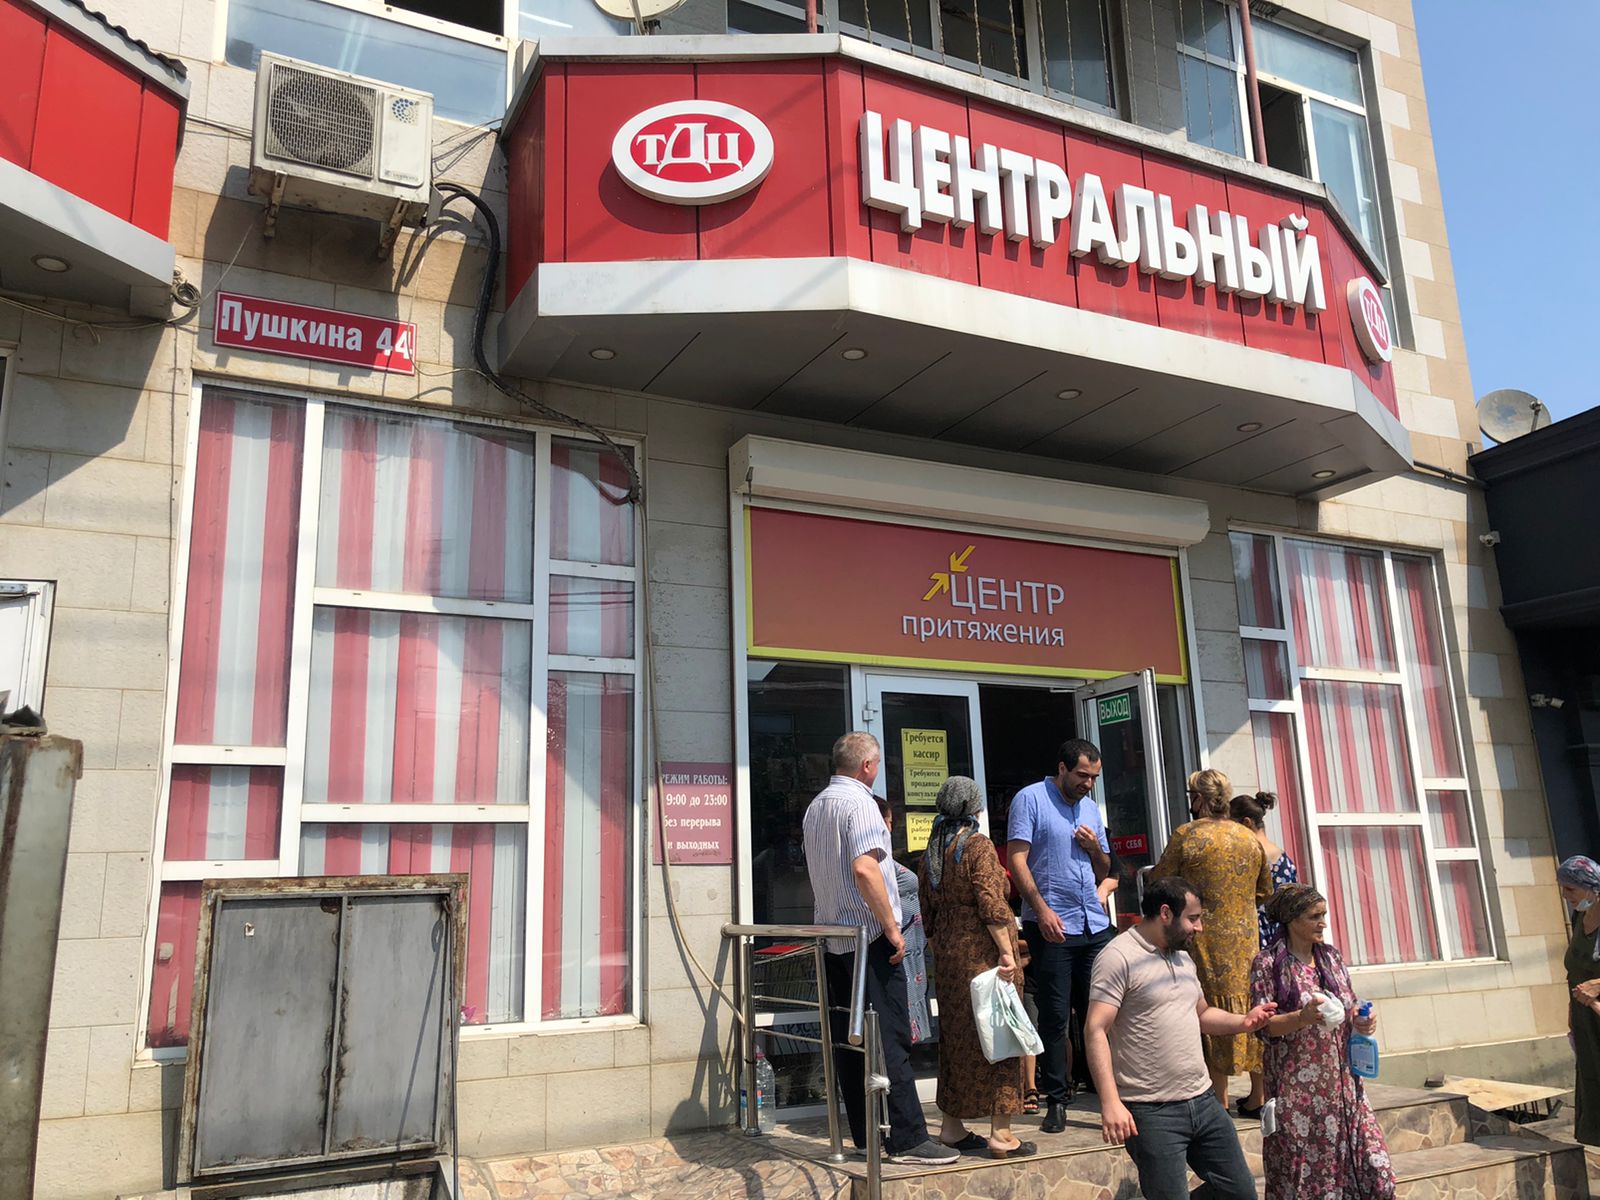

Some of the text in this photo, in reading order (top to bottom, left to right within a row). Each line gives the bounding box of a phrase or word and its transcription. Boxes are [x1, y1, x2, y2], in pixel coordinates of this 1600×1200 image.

[860, 110, 1326, 314] ЦЕНТРАЛЬНЫЙ
[221, 299, 413, 359] Пушкина 44
[951, 574, 1065, 615] ЦЕНТР
[902, 615, 1065, 647] притяжения
[1100, 698, 1129, 720] ВЫХОД
[905, 732, 944, 746] Требуется
[913, 750, 940, 761] кассир
[693, 774, 728, 785] РАБОТЫ:
[910, 769, 941, 778] Требуются
[666, 793, 728, 807] 9:00 до 23:00
[680, 818, 721, 829] перерыва
[676, 841, 720, 850] выходных
[1112, 838, 1143, 850] ОТ СЕБЯ
